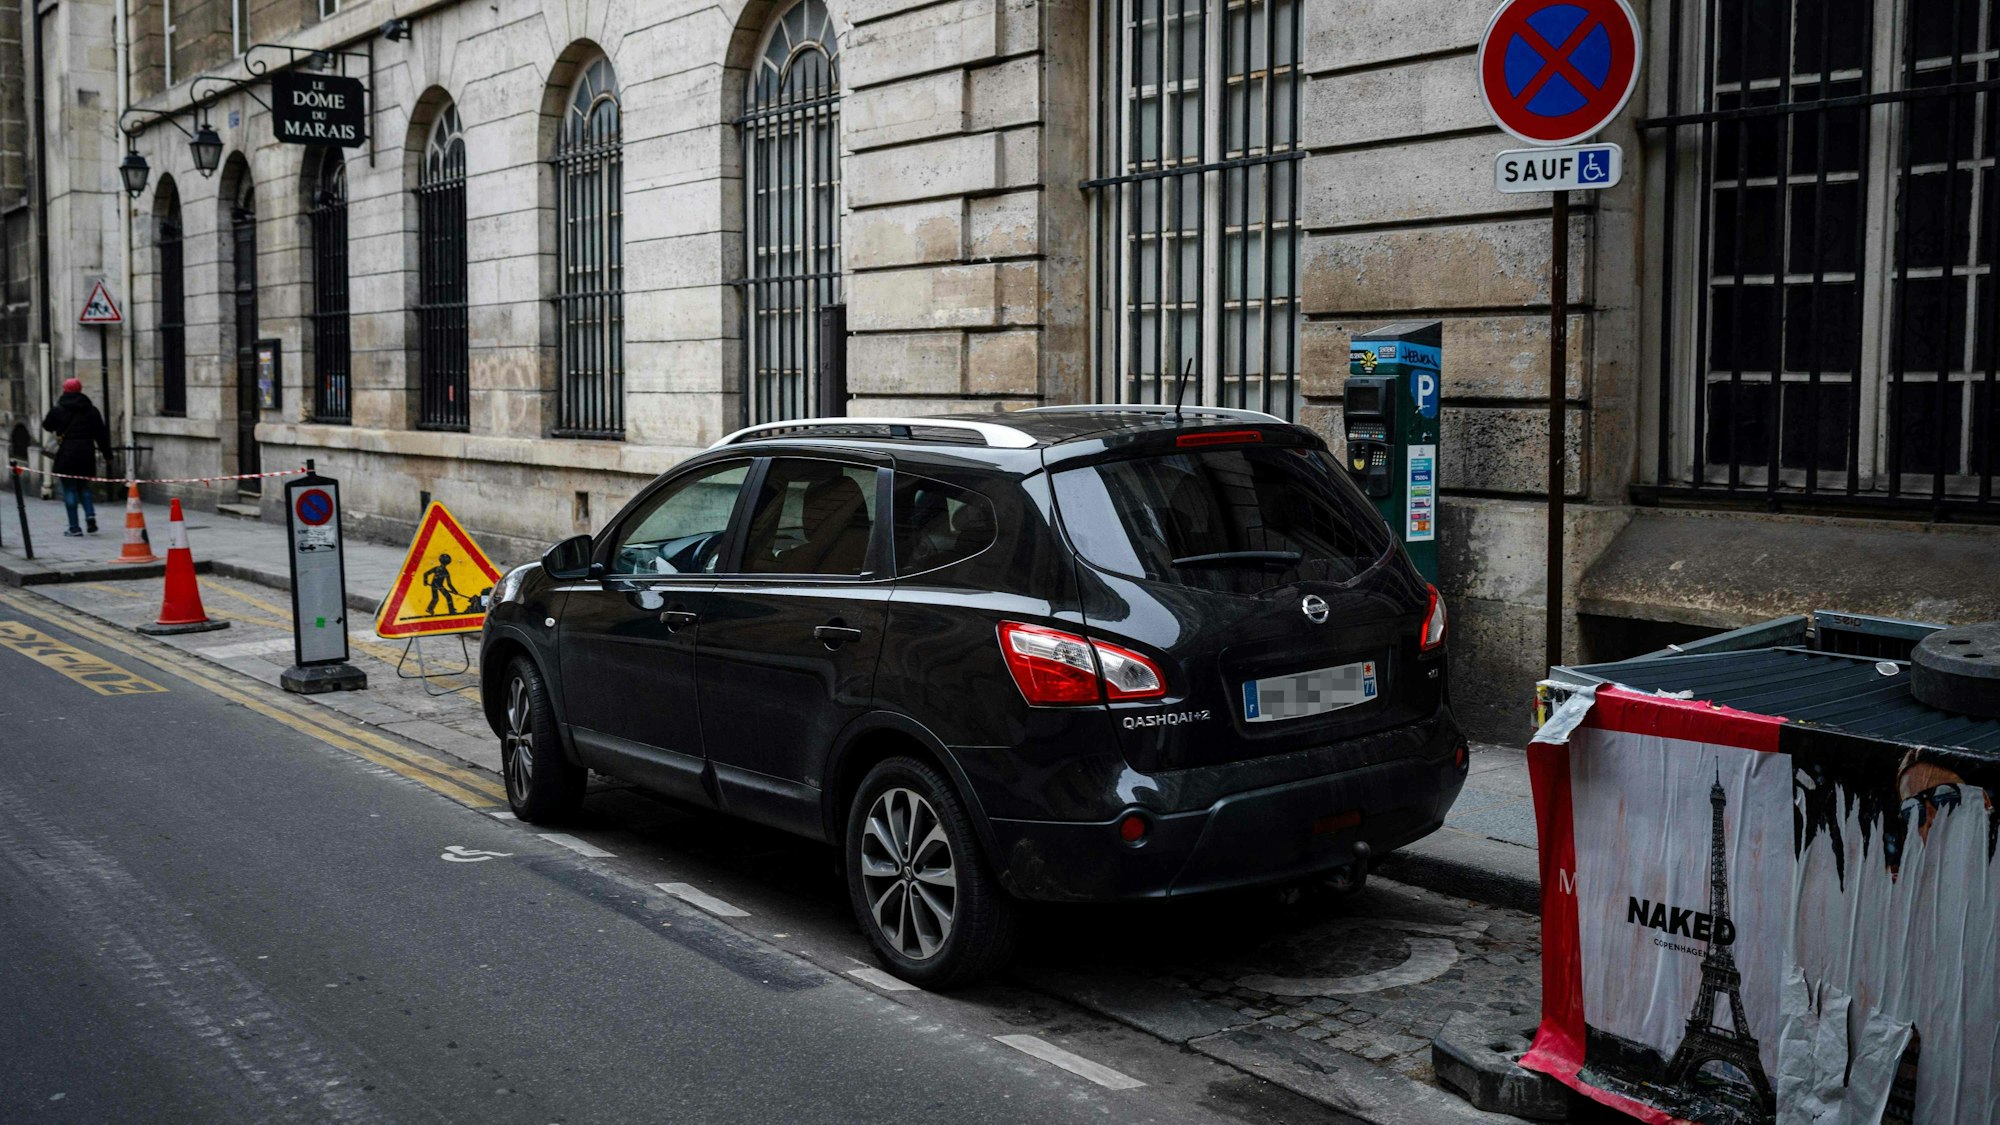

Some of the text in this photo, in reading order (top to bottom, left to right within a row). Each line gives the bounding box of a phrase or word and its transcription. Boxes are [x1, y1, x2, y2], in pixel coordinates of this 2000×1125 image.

[312, 81, 325, 90] LE
[293, 90, 345, 109] DÔME
[312, 111, 326, 120] DU
[284, 120, 355, 139] MARAIS
[1504, 157, 1573, 182] SAUF
[1417, 374, 1434, 410] P
[1364, 680, 1375, 694] 77
[1249, 703, 1255, 713] F
[1122, 710, 1211, 730] QASHQAI+2
[1627, 896, 1736, 946] NAKED
